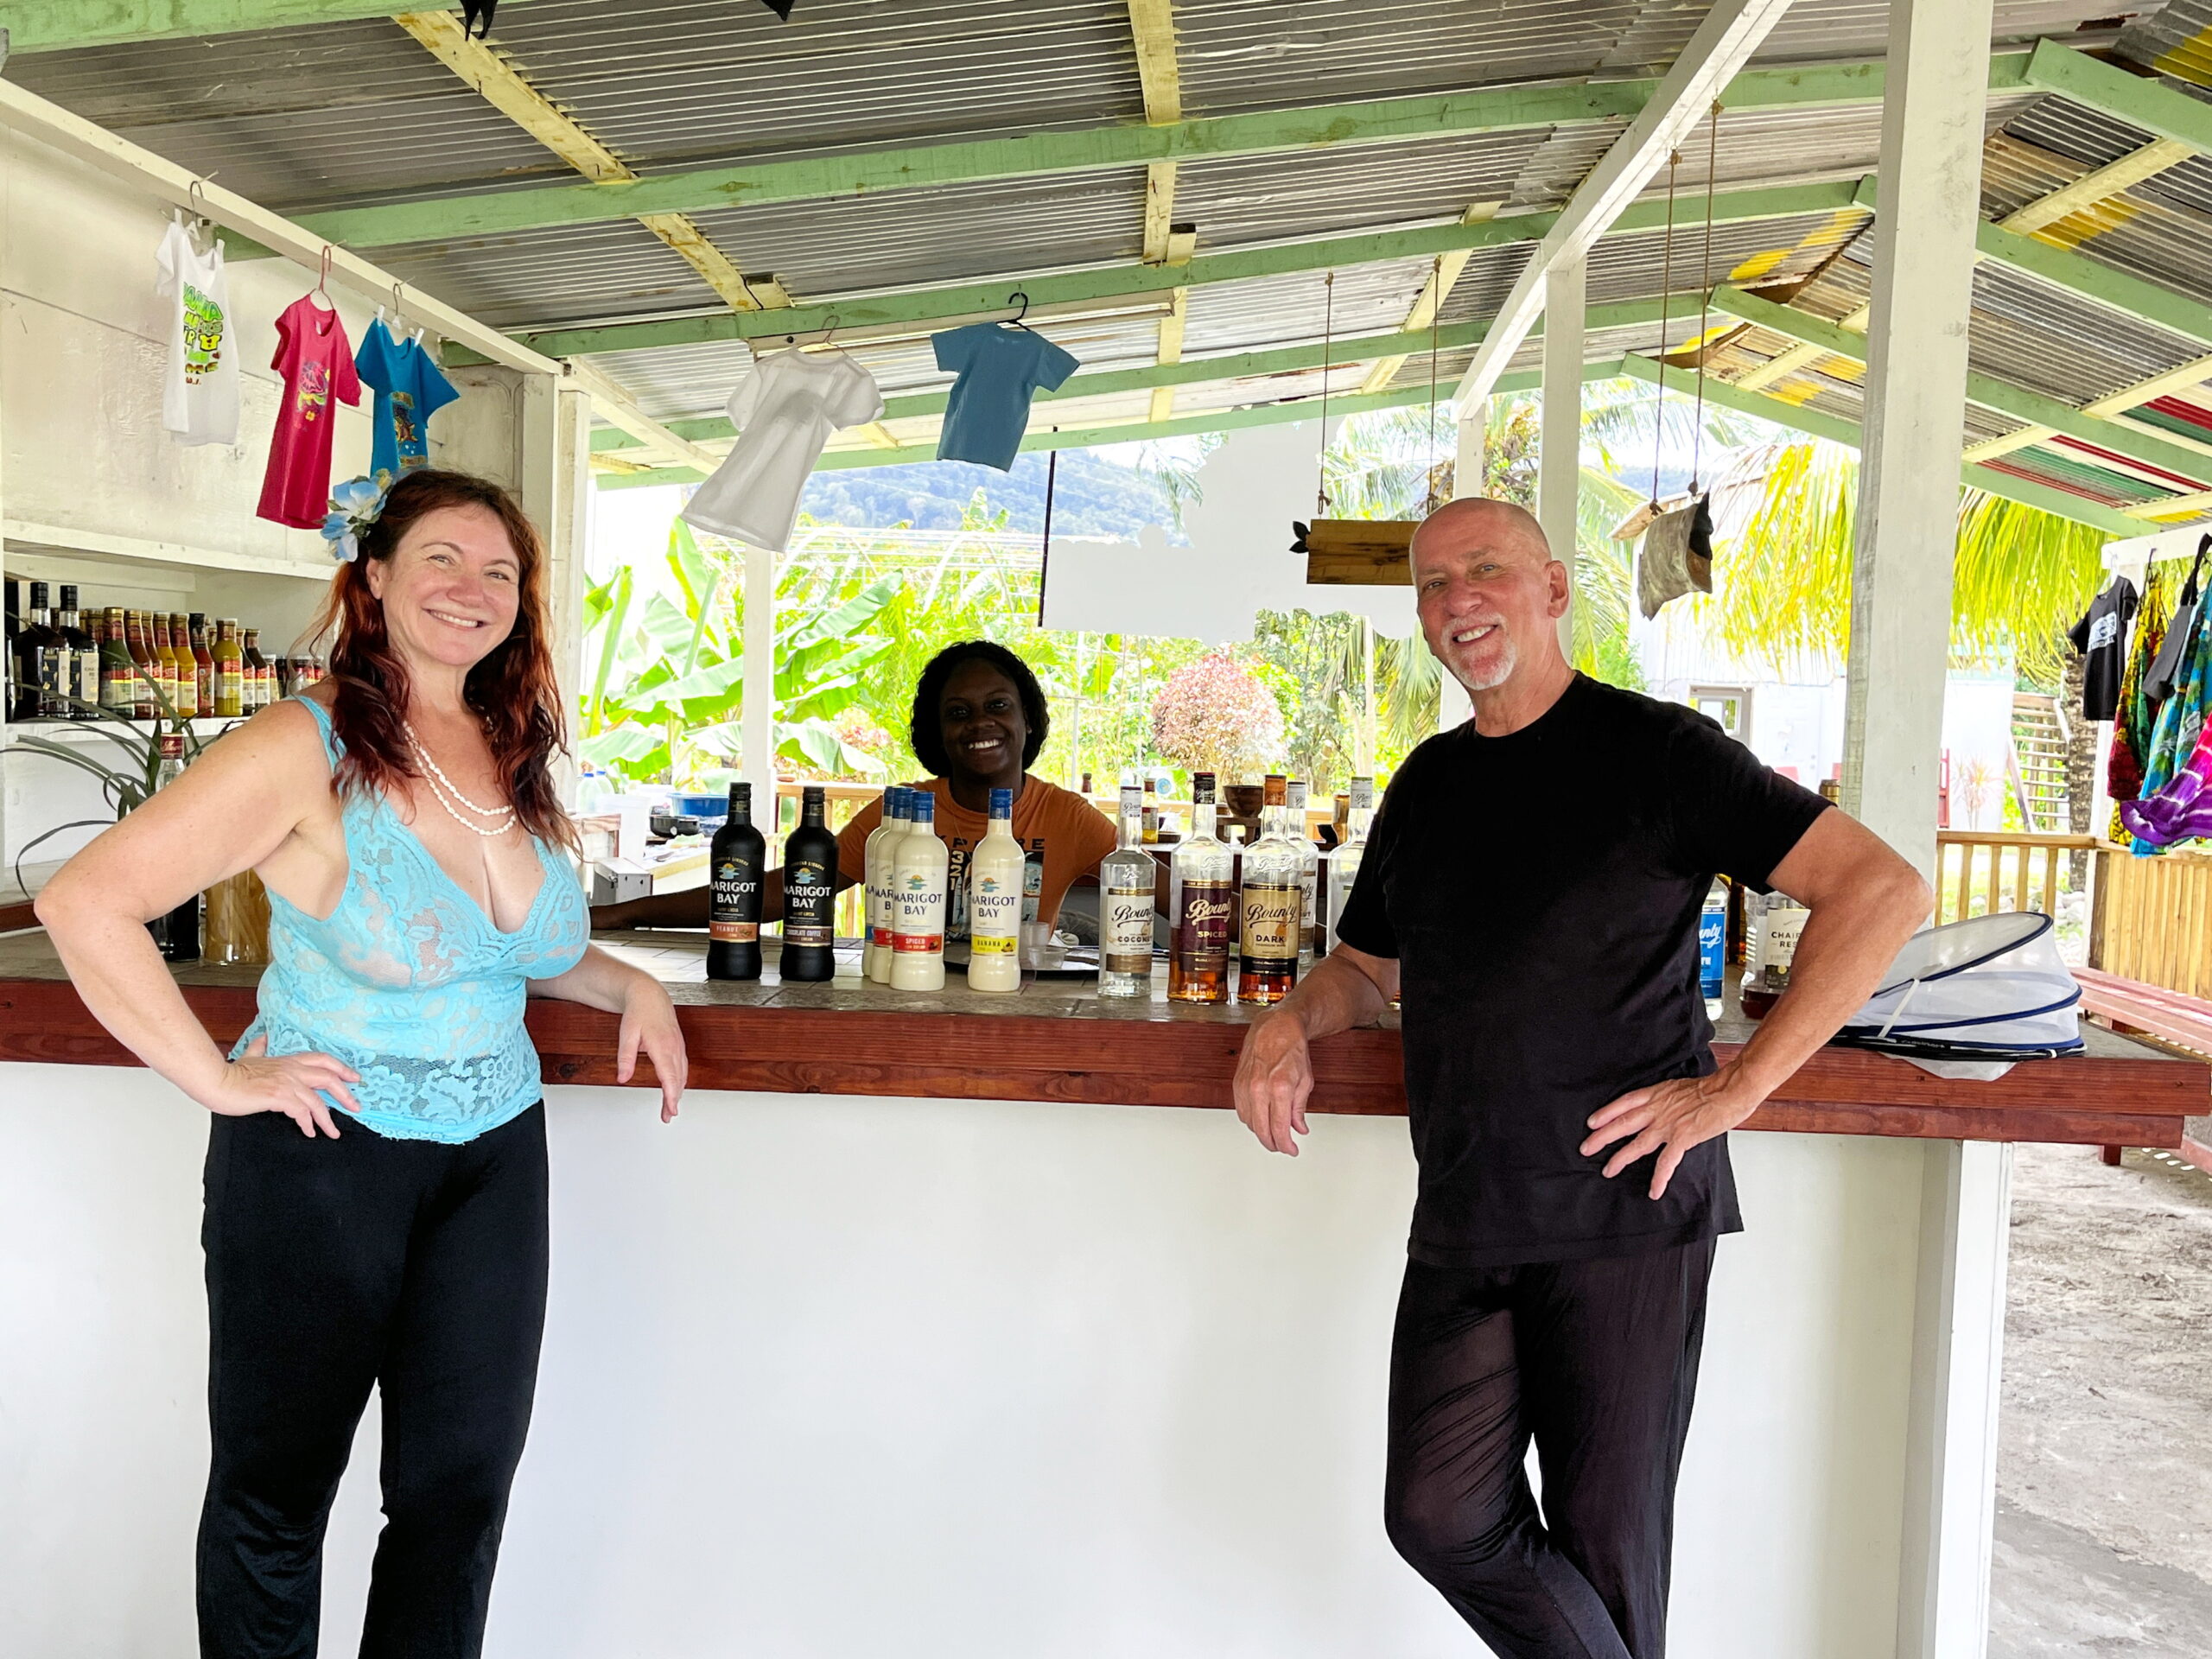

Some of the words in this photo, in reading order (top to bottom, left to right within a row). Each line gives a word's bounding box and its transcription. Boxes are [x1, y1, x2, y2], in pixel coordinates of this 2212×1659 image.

[951, 850, 964, 864] 3
[950, 865, 963, 877] 2
[950, 878, 957, 891] 1
[716, 893, 741, 905] BAY
[792, 898, 817, 909] BAY
[904, 905, 928, 916] BAY
[978, 907, 1000, 918] BAY
[1245, 903, 1298, 929] Bounty
[715, 925, 739, 933] PEANUT
[786, 928, 806, 937] CHOCOLATE
[1255, 934, 1286, 943] DARK
